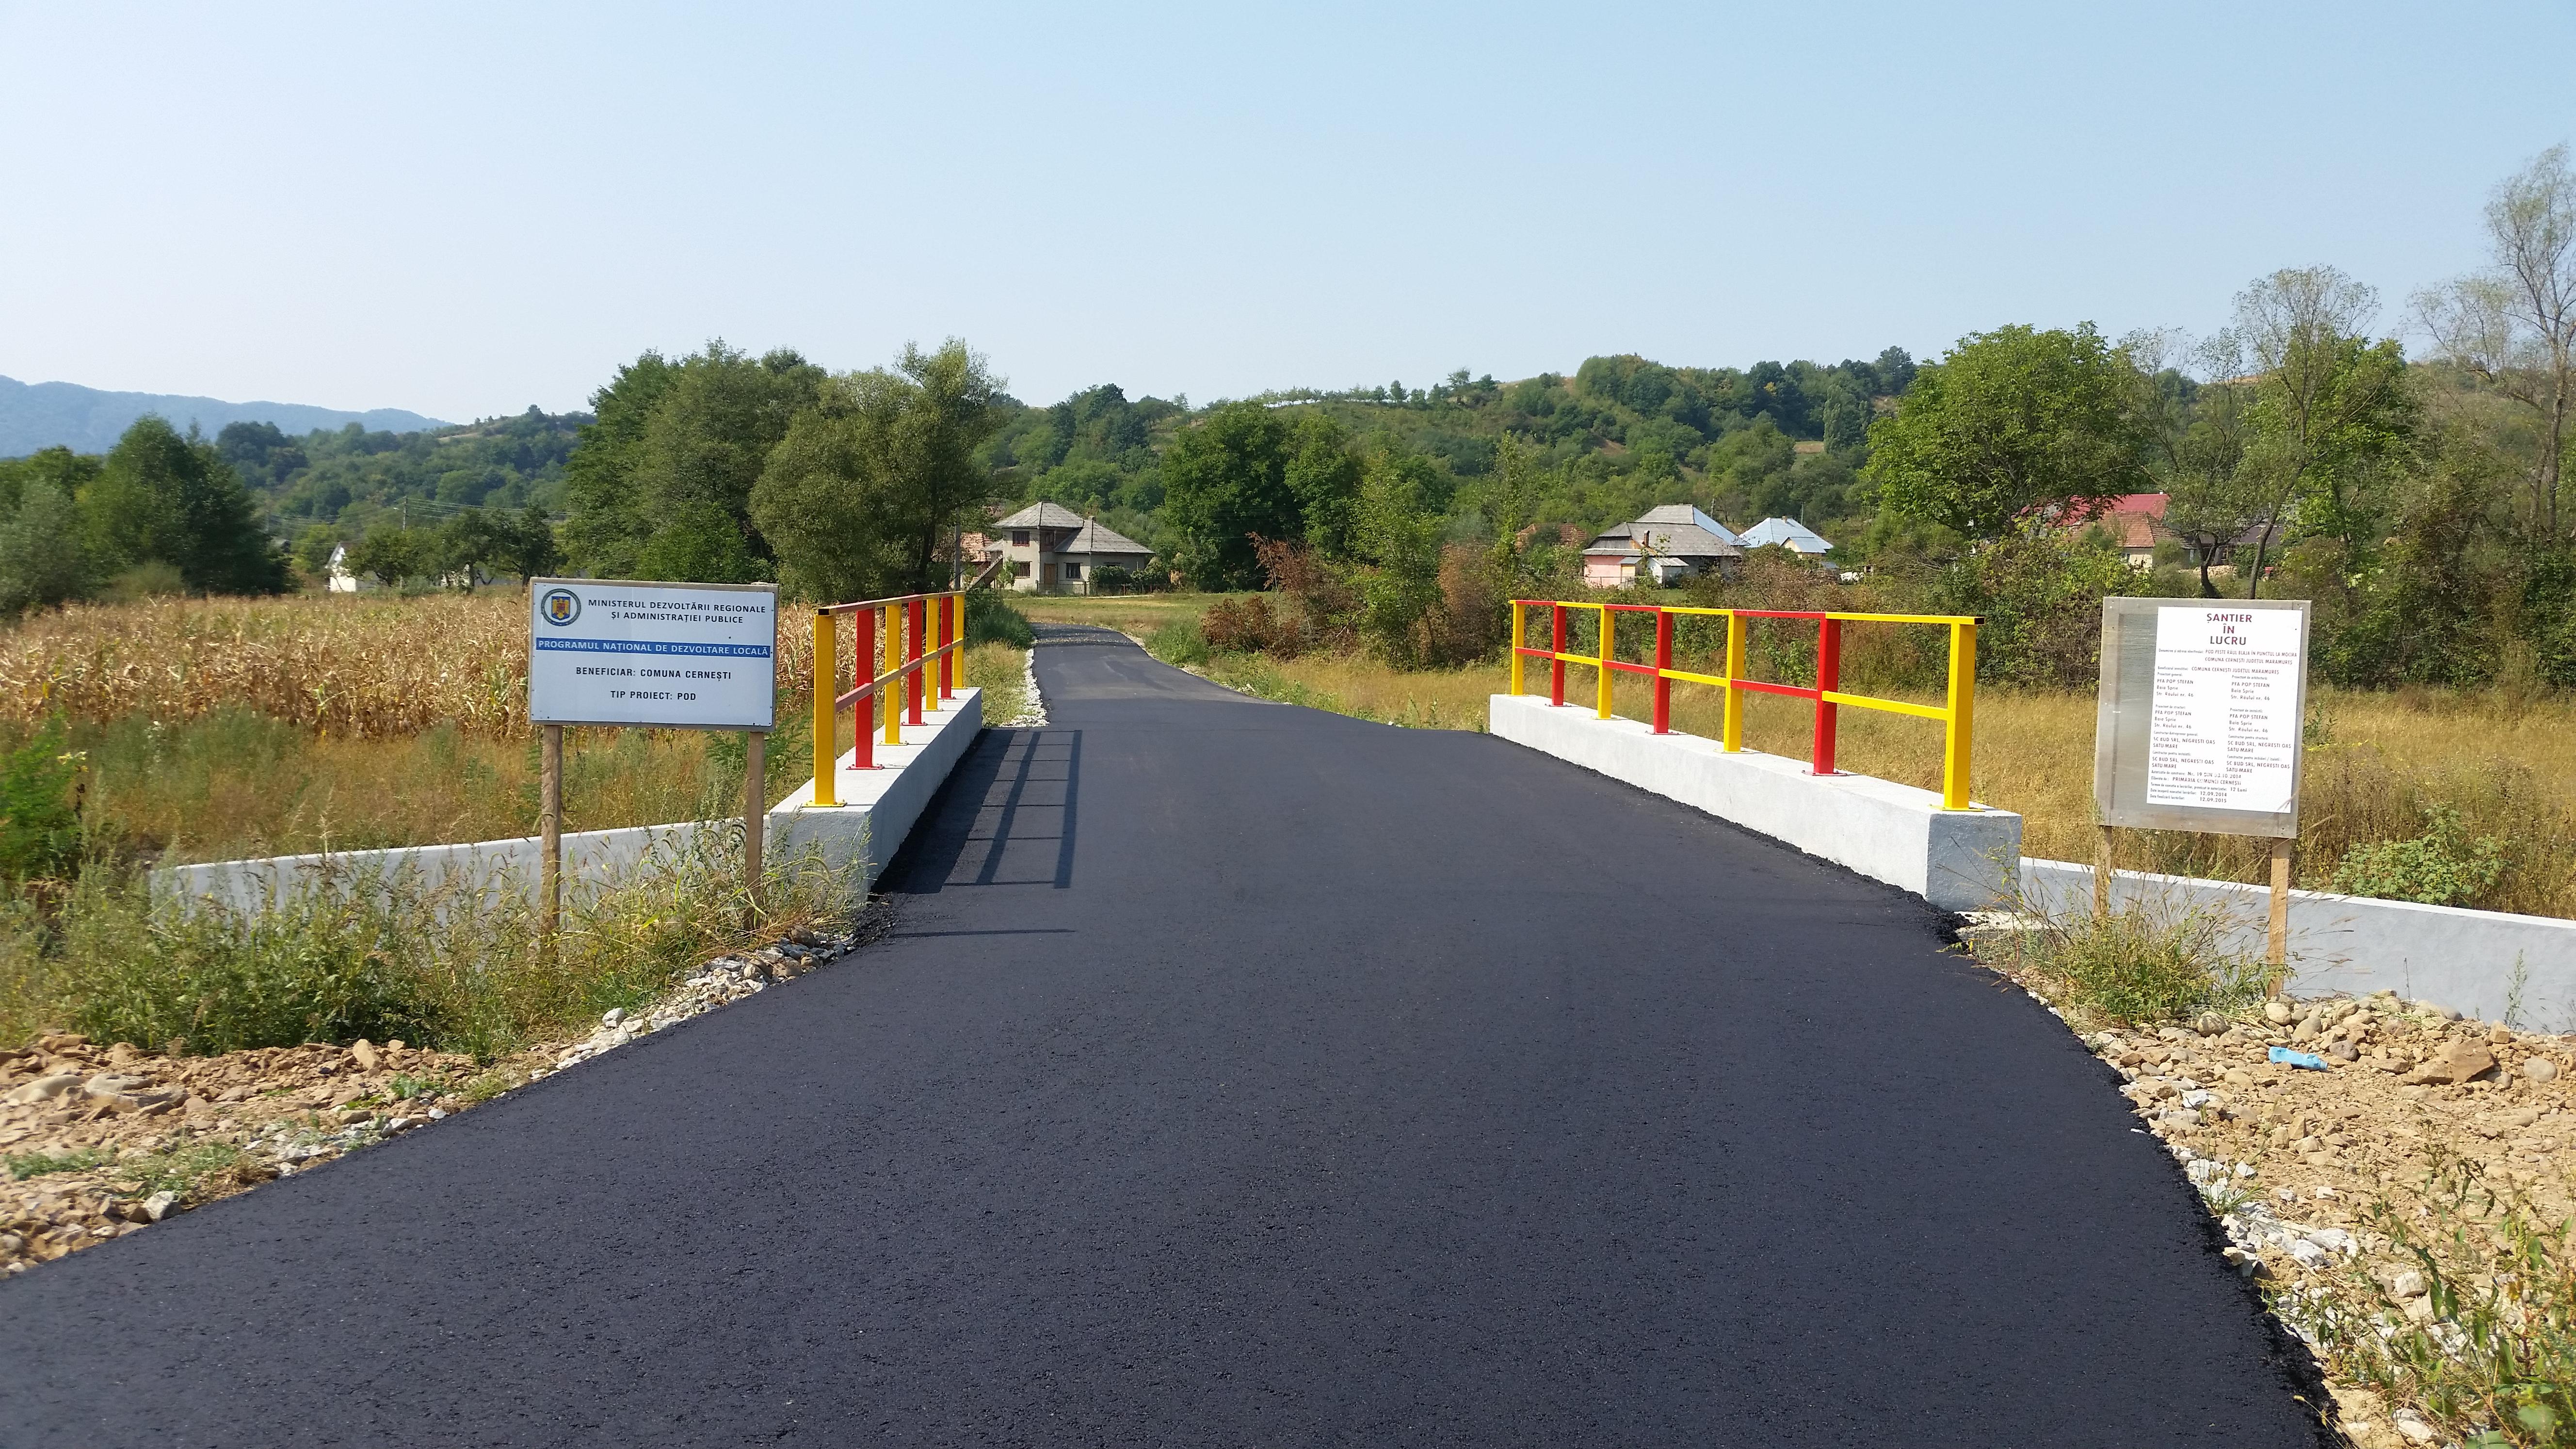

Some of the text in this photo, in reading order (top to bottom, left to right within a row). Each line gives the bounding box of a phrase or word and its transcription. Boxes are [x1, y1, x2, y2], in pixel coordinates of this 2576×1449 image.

[588, 599, 766, 613] MINISTERUL DEZVOLTĂRII REGIONALE
[611, 612, 743, 623] ȘI ADMINISTRAȚIEI PUBLICE
[2207, 613, 2252, 623] ȘANTIER
[2223, 623, 2234, 634] ÎN
[2210, 636, 2246, 645] LUCRU
[538, 641, 599, 649] PROGRAMUL
[603, 642, 652, 652] NAȚIONAL
[671, 644, 729, 654] DEZVOLTARE
[733, 646, 768, 656] LOCALĂ
[576, 667, 731, 681] BENEFICIAR: COMUNA CERNEȘTI
[630, 692, 673, 700] PROIECT:
[677, 692, 696, 701] POD
